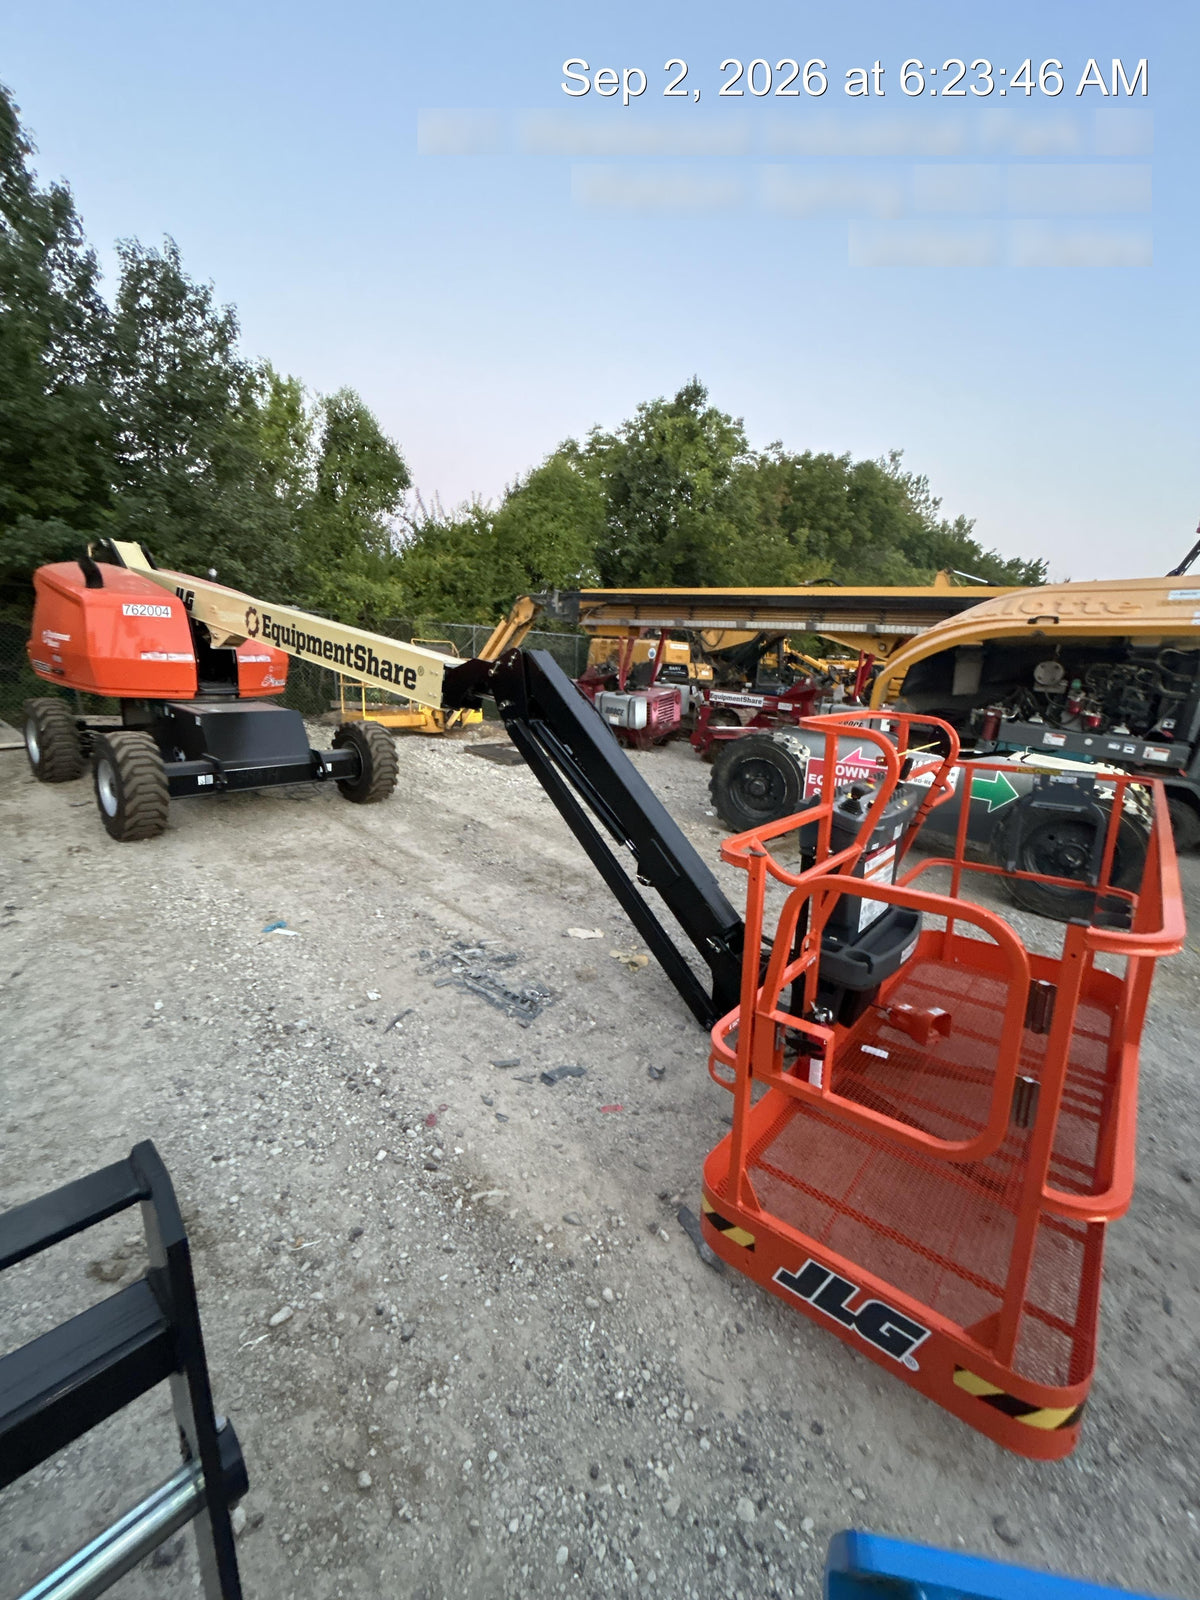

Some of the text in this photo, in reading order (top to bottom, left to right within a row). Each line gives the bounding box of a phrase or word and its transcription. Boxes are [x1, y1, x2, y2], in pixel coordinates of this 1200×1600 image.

[124, 604, 170, 617] 762004
[262, 614, 417, 691] EquipmentShare
[710, 692, 763, 705] EquipmentShare
[772, 1258, 932, 1363] JLG
